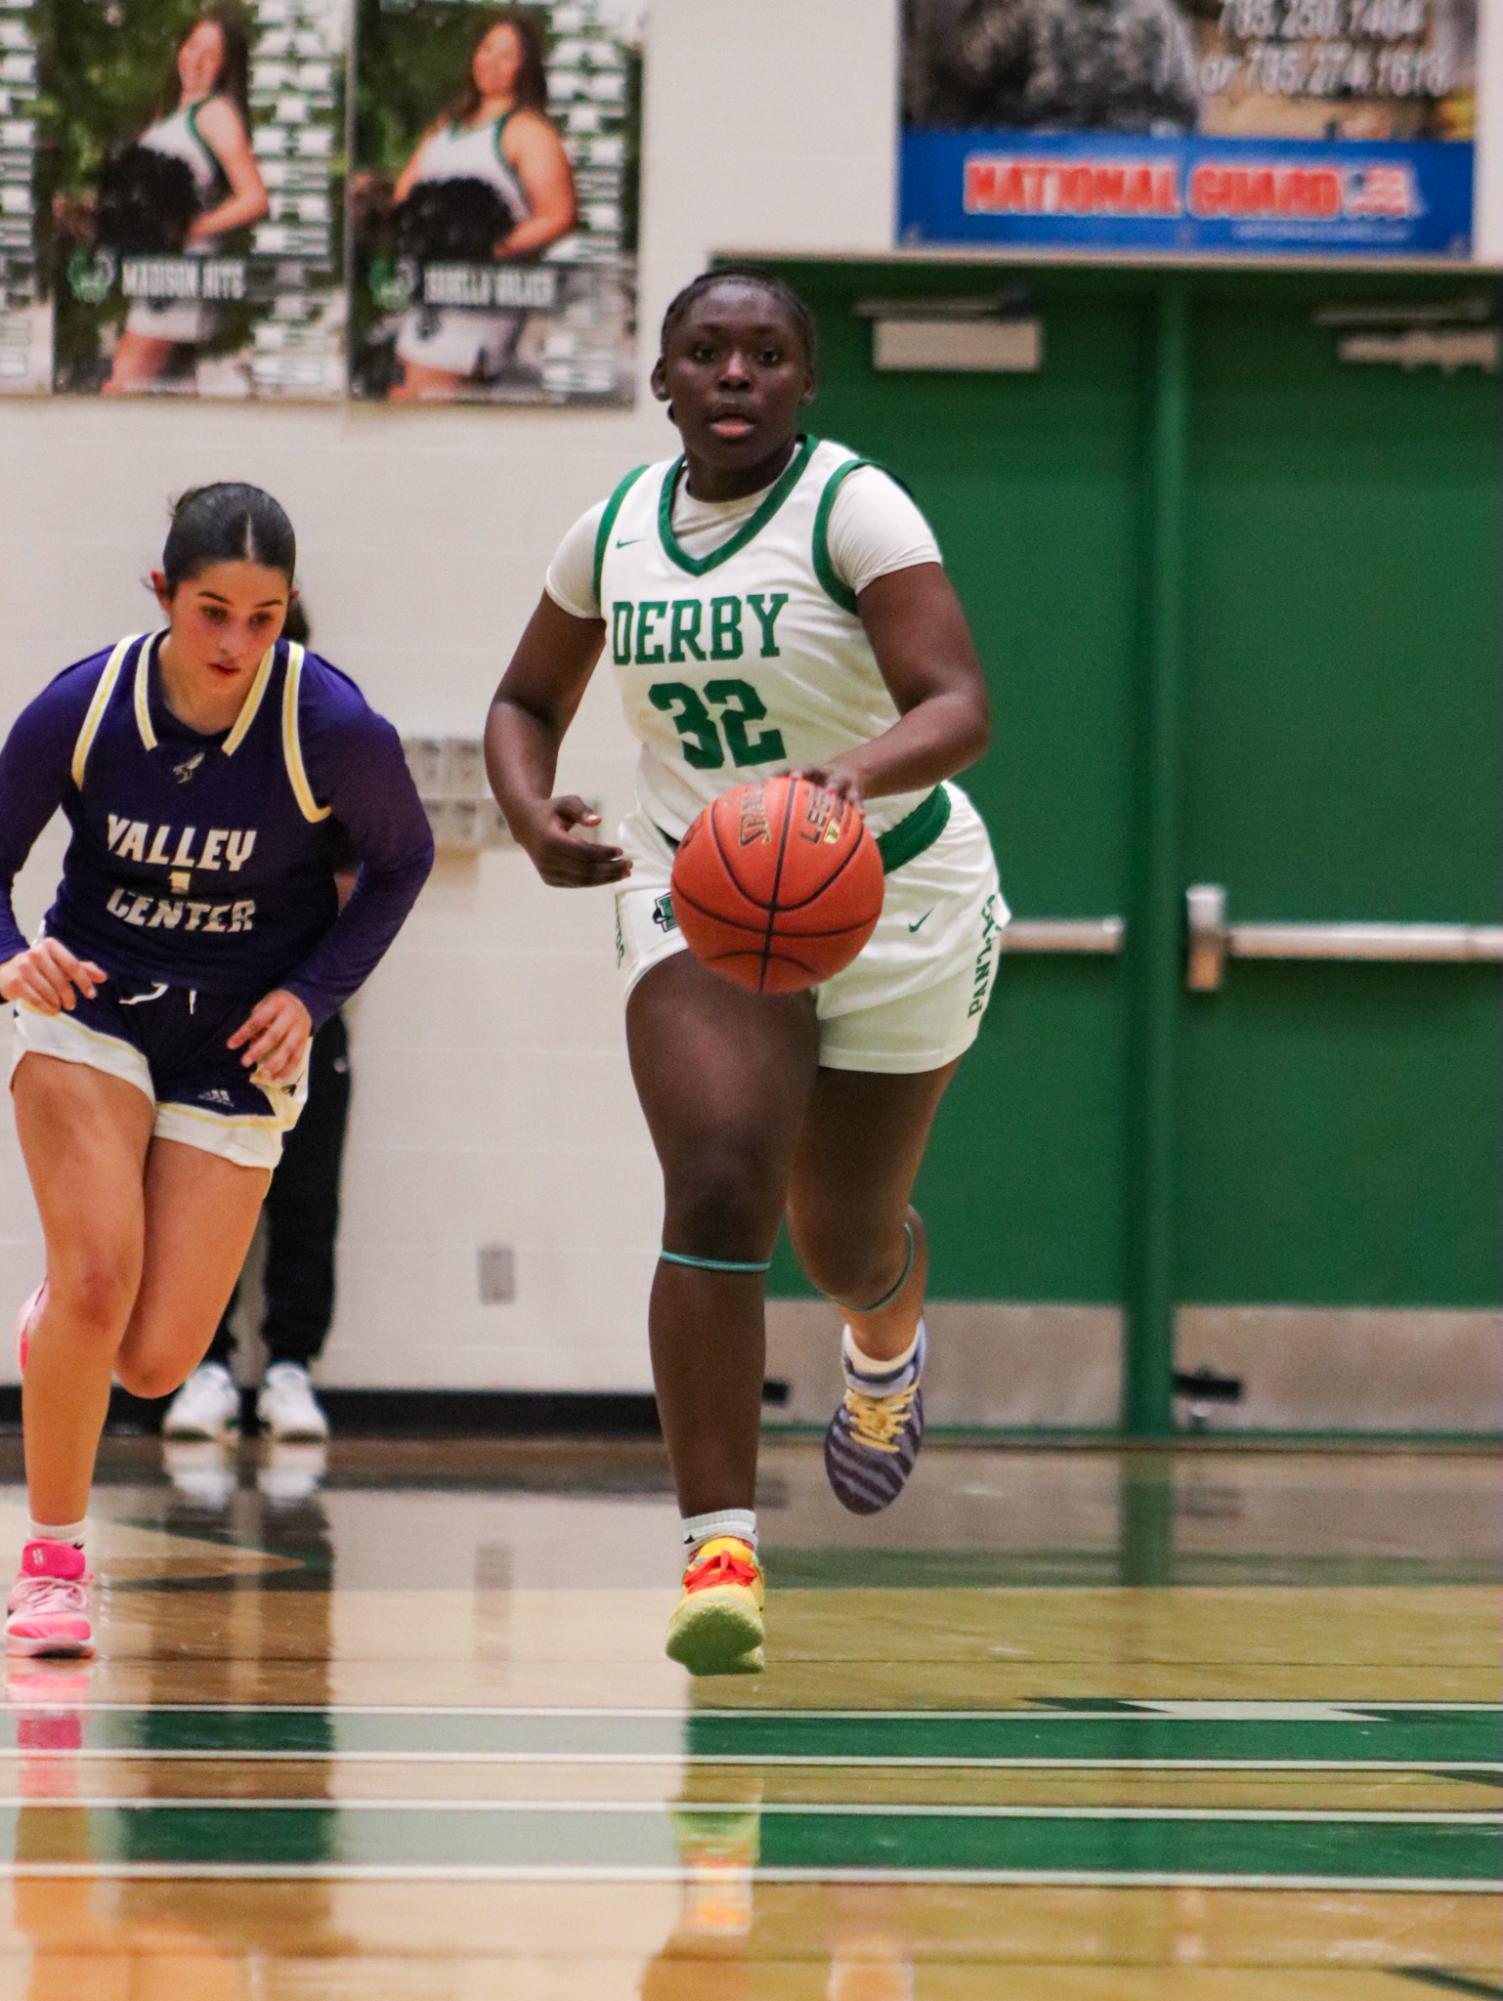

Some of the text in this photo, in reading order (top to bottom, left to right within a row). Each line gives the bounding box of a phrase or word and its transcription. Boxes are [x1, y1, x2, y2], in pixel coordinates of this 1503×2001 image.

[964, 158, 1342, 218] NATIONAL GUARD
[612, 592, 790, 667] DERBY
[647, 678, 788, 771] 32
[106, 813, 258, 872] VALLEY
[105, 888, 257, 933] CENTER
